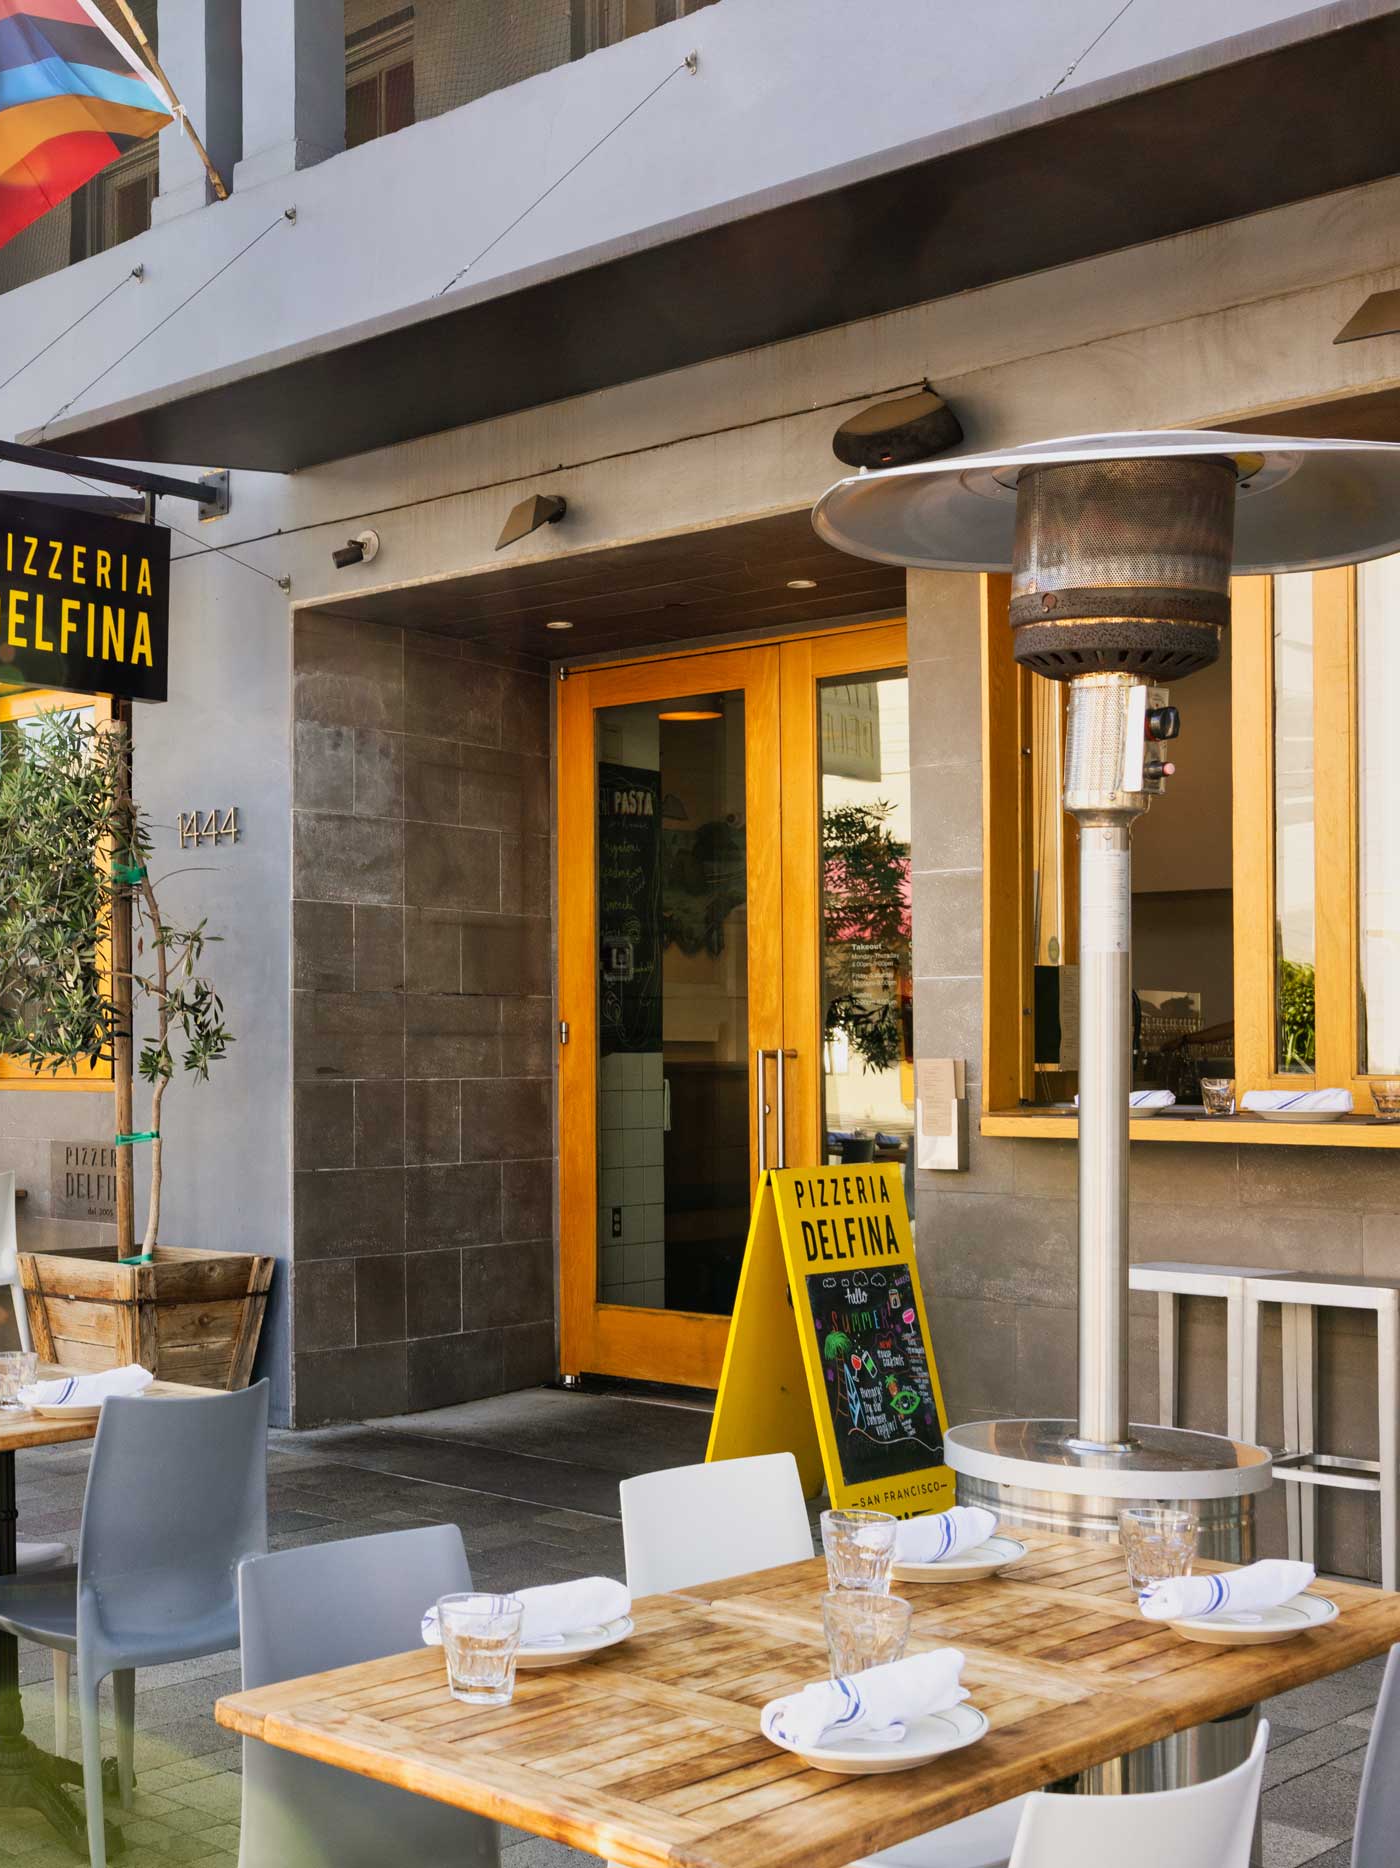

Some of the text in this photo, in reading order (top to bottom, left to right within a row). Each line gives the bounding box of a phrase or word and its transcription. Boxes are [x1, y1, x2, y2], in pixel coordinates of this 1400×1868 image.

[614, 790, 654, 816] PASTA
[177, 807, 238, 849] 1444
[852, 943, 882, 951] Takeout
[66, 1146, 117, 1168] PIZZER
[65, 1172, 117, 1202] DELFI
[794, 1175, 890, 1209] PIZZERIA
[801, 1214, 900, 1262] DELFINA
[844, 1287, 869, 1305] hello
[831, 1301, 894, 1334] SUMMER!
